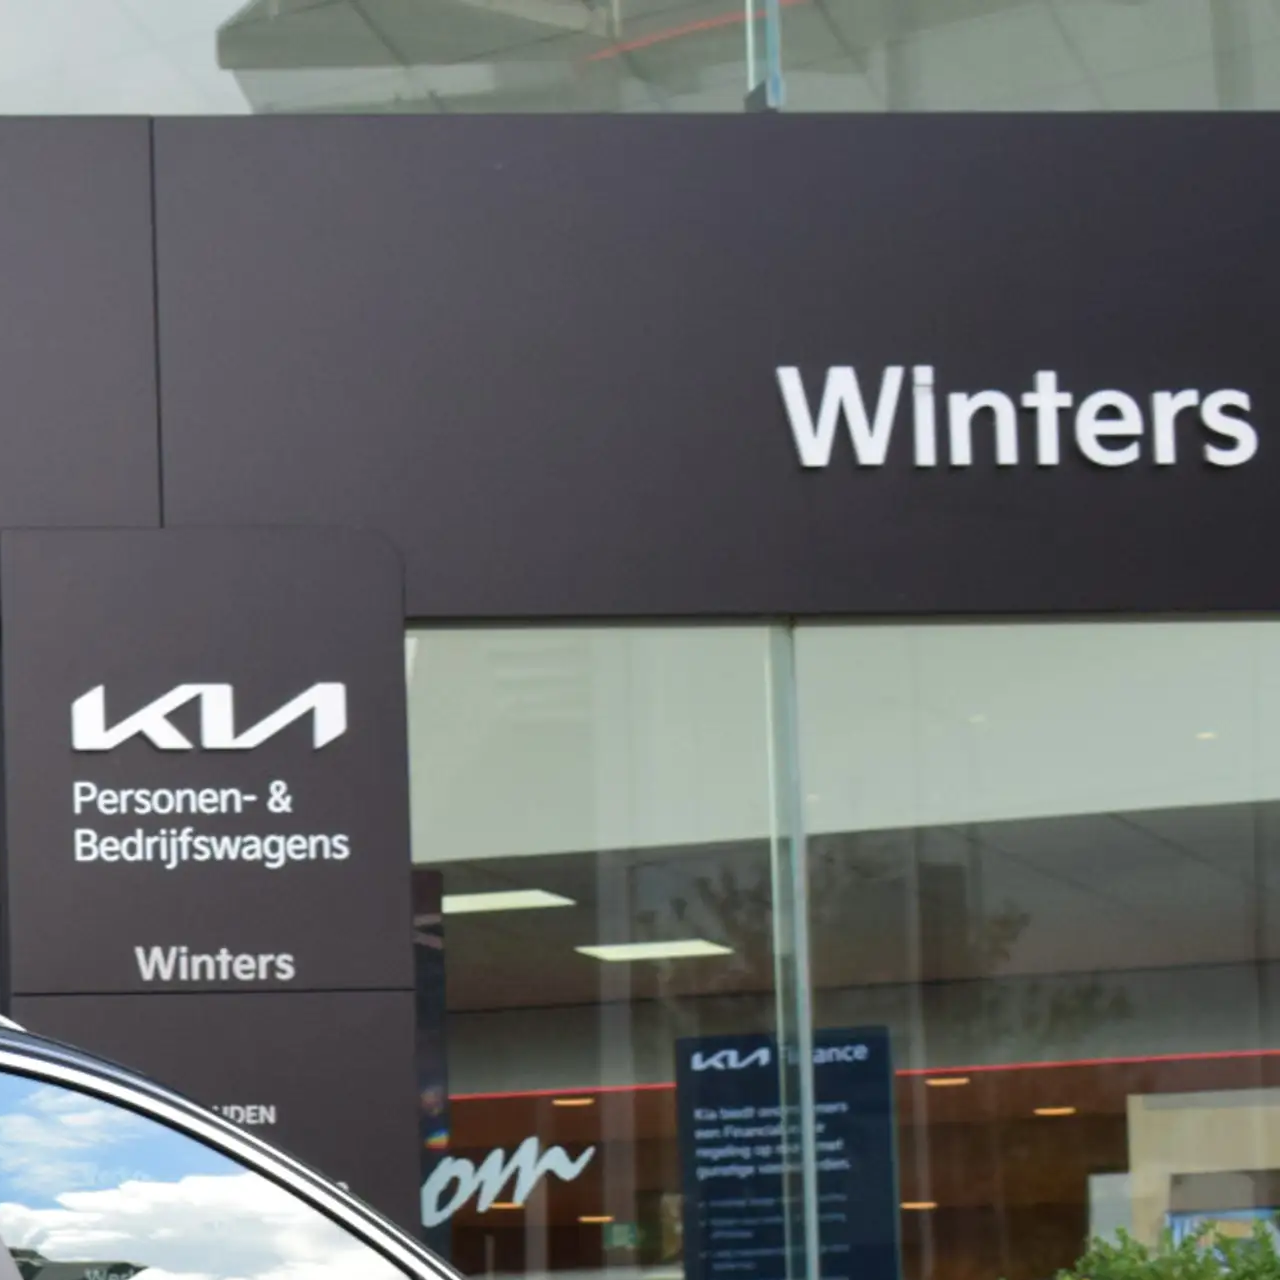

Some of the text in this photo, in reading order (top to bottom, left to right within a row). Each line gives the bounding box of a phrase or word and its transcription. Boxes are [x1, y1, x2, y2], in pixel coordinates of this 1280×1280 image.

[776, 364, 1258, 468] Winters
[71, 682, 348, 750] KIA
[73, 779, 293, 815] Personen- &
[73, 826, 351, 870] Bedrijfswagens
[134, 945, 296, 981] Winters
[691, 1047, 771, 1071] KIA
